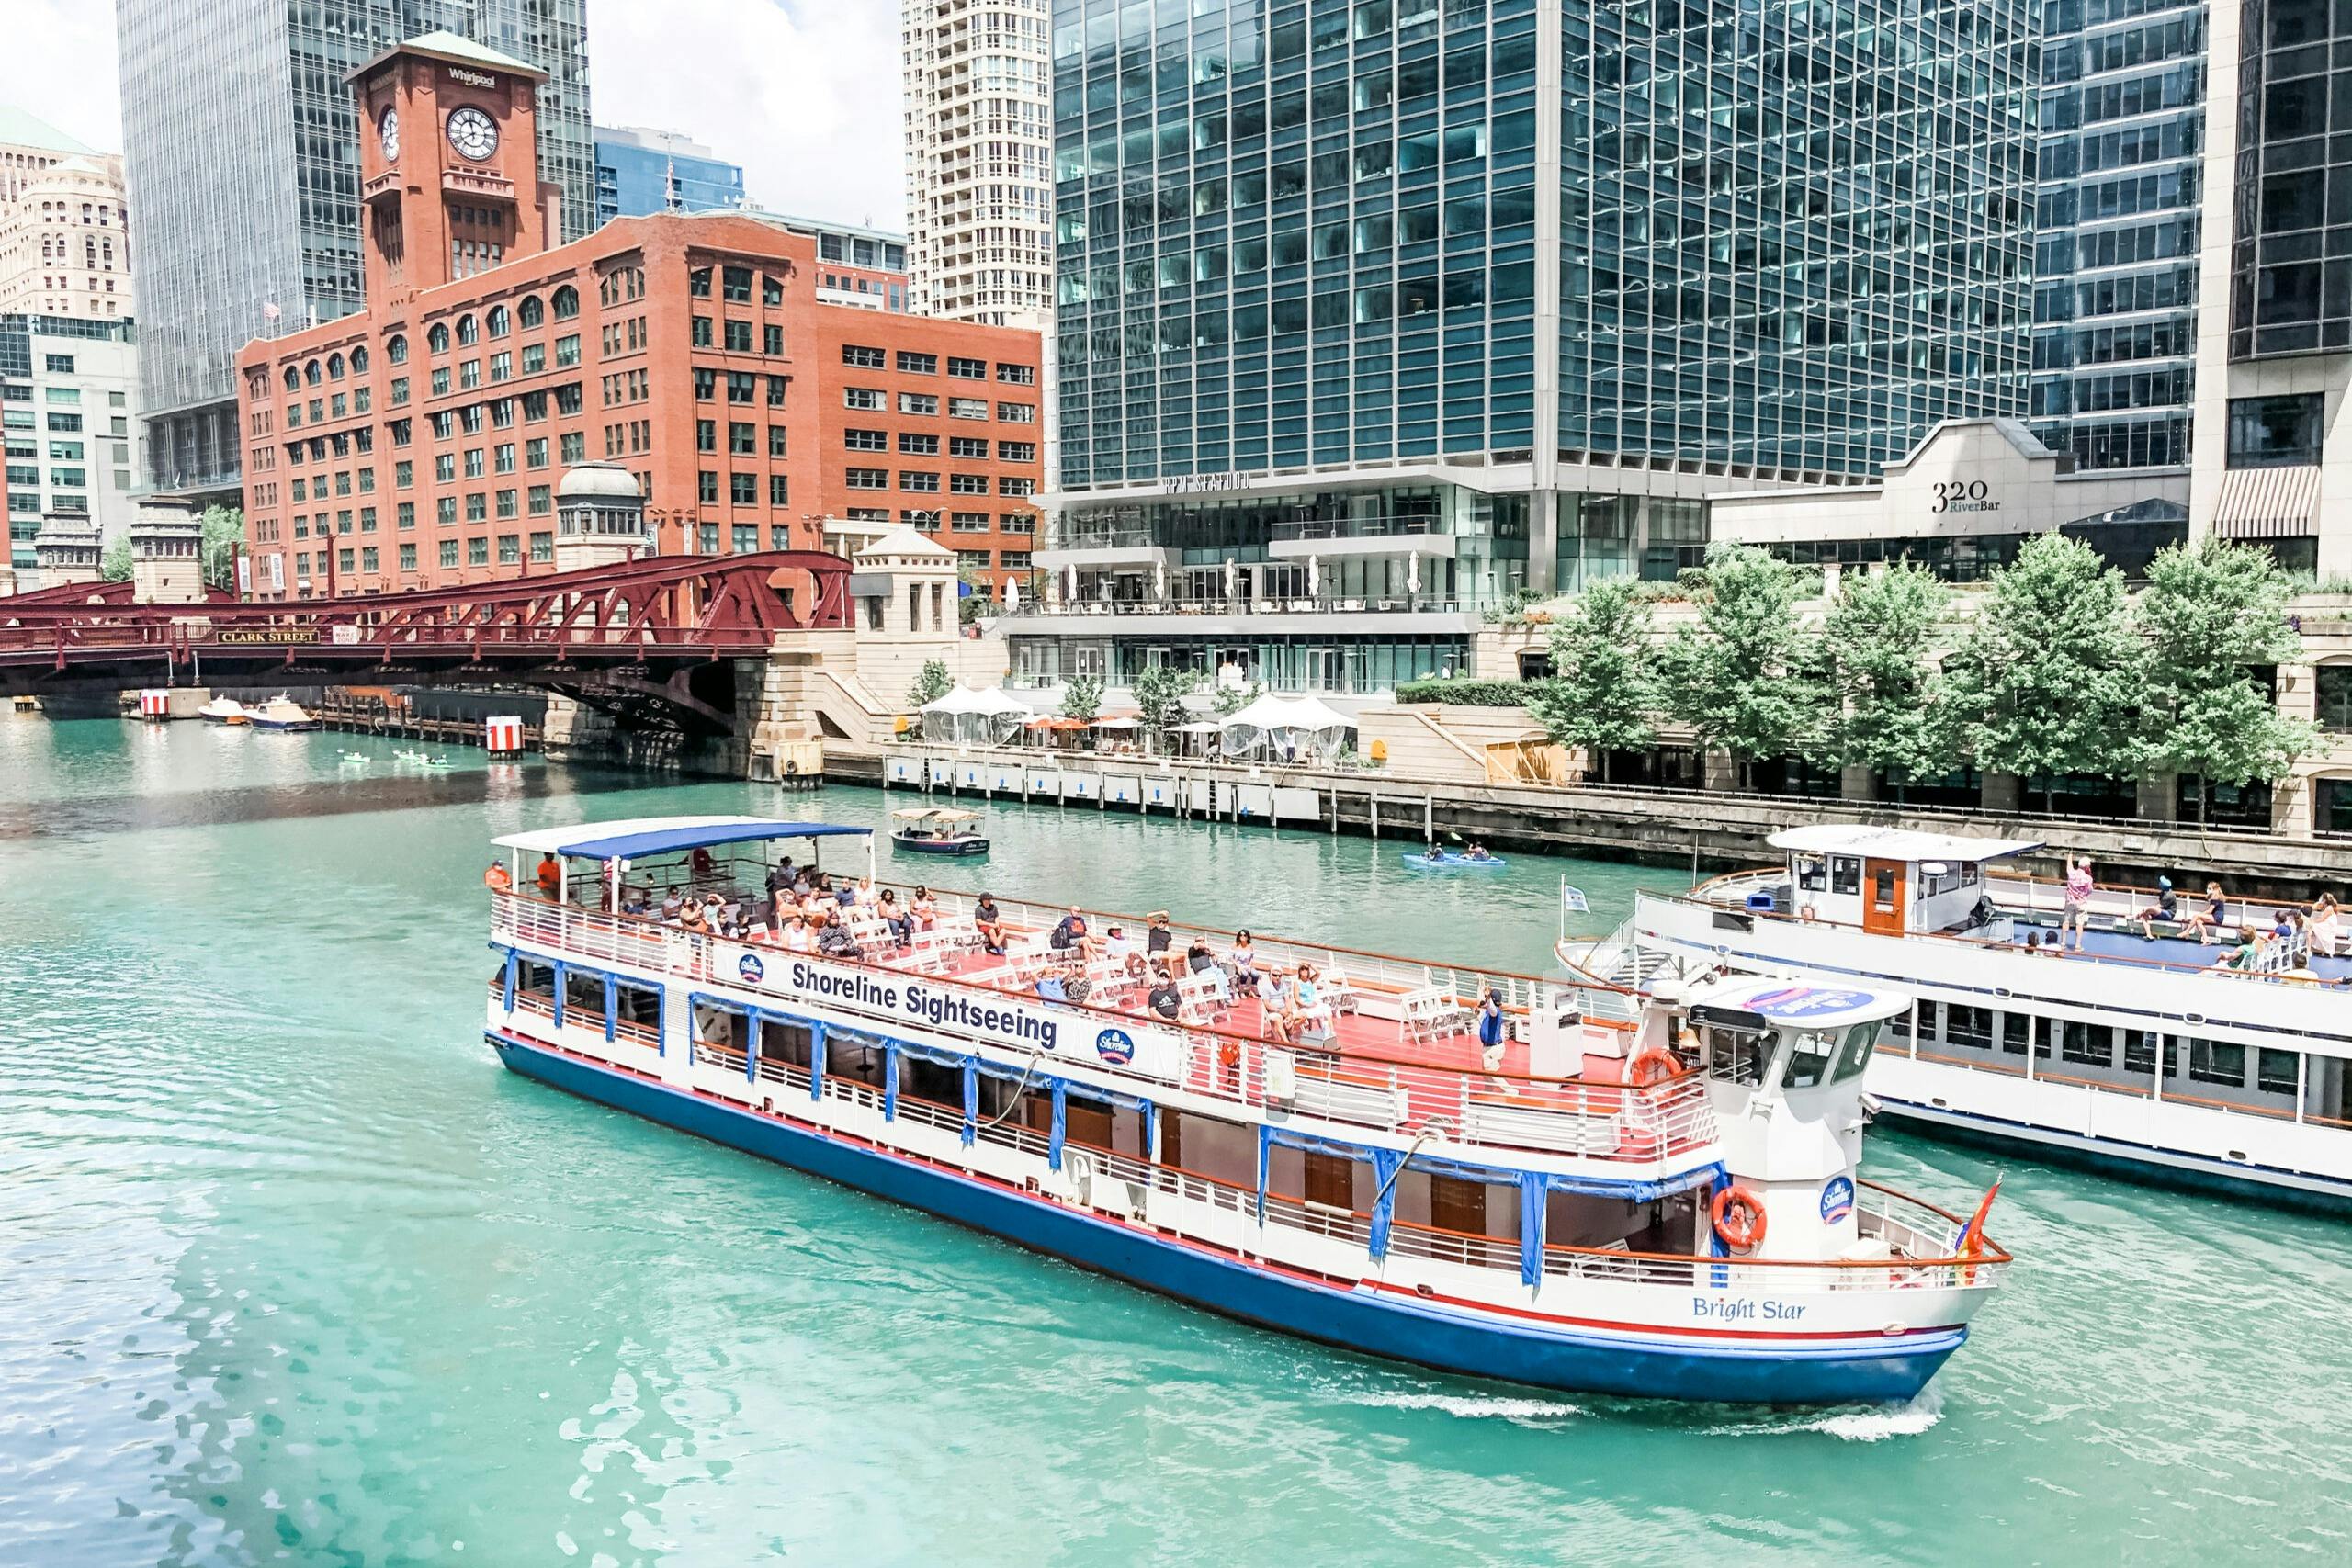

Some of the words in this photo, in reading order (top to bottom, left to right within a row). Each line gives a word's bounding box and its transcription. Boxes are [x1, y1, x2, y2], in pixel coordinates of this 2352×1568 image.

[448, 67, 495, 85] Whirlpool
[1165, 476, 1188, 494] RPM
[1196, 471, 1250, 492] SEAFOOD
[1932, 480, 1988, 513] 320
[1950, 501, 2000, 513] RiverBar
[221, 632, 266, 642] CLARK
[268, 631, 315, 642] STREET
[793, 962, 898, 1008] Shoreline
[906, 986, 1057, 1049] Sightseeing
[1693, 1297, 1756, 1322] Bright
[1762, 1301, 1806, 1320] Star
